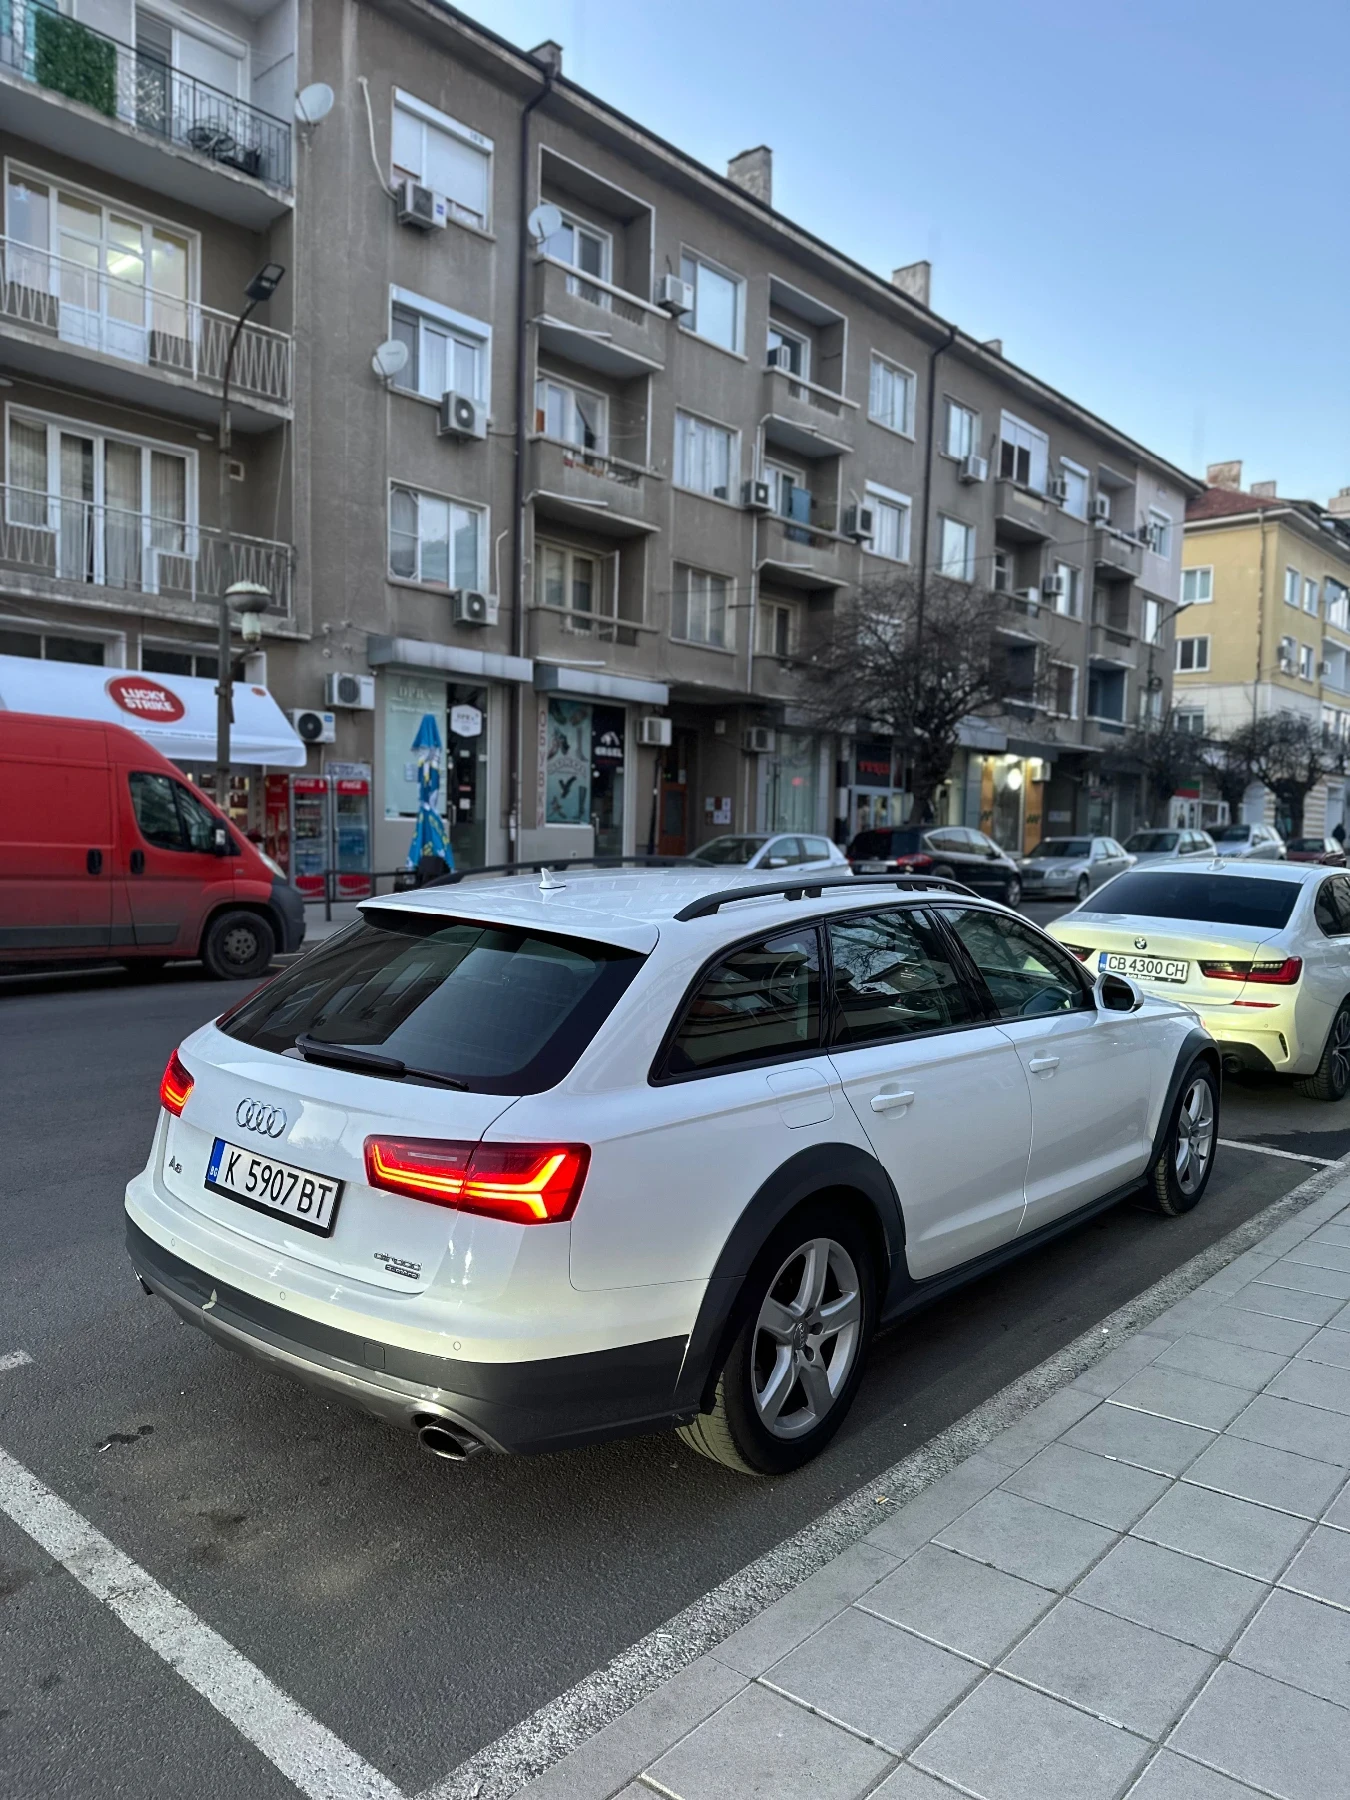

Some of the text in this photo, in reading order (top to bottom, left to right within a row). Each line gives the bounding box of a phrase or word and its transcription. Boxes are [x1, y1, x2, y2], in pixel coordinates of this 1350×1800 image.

[120, 687, 166, 702] LUCKY
[124, 698, 176, 713] STRIKE
[1108, 956, 1186, 978] CB 4300 CH
[224, 1151, 333, 1219] K 5907 BT
